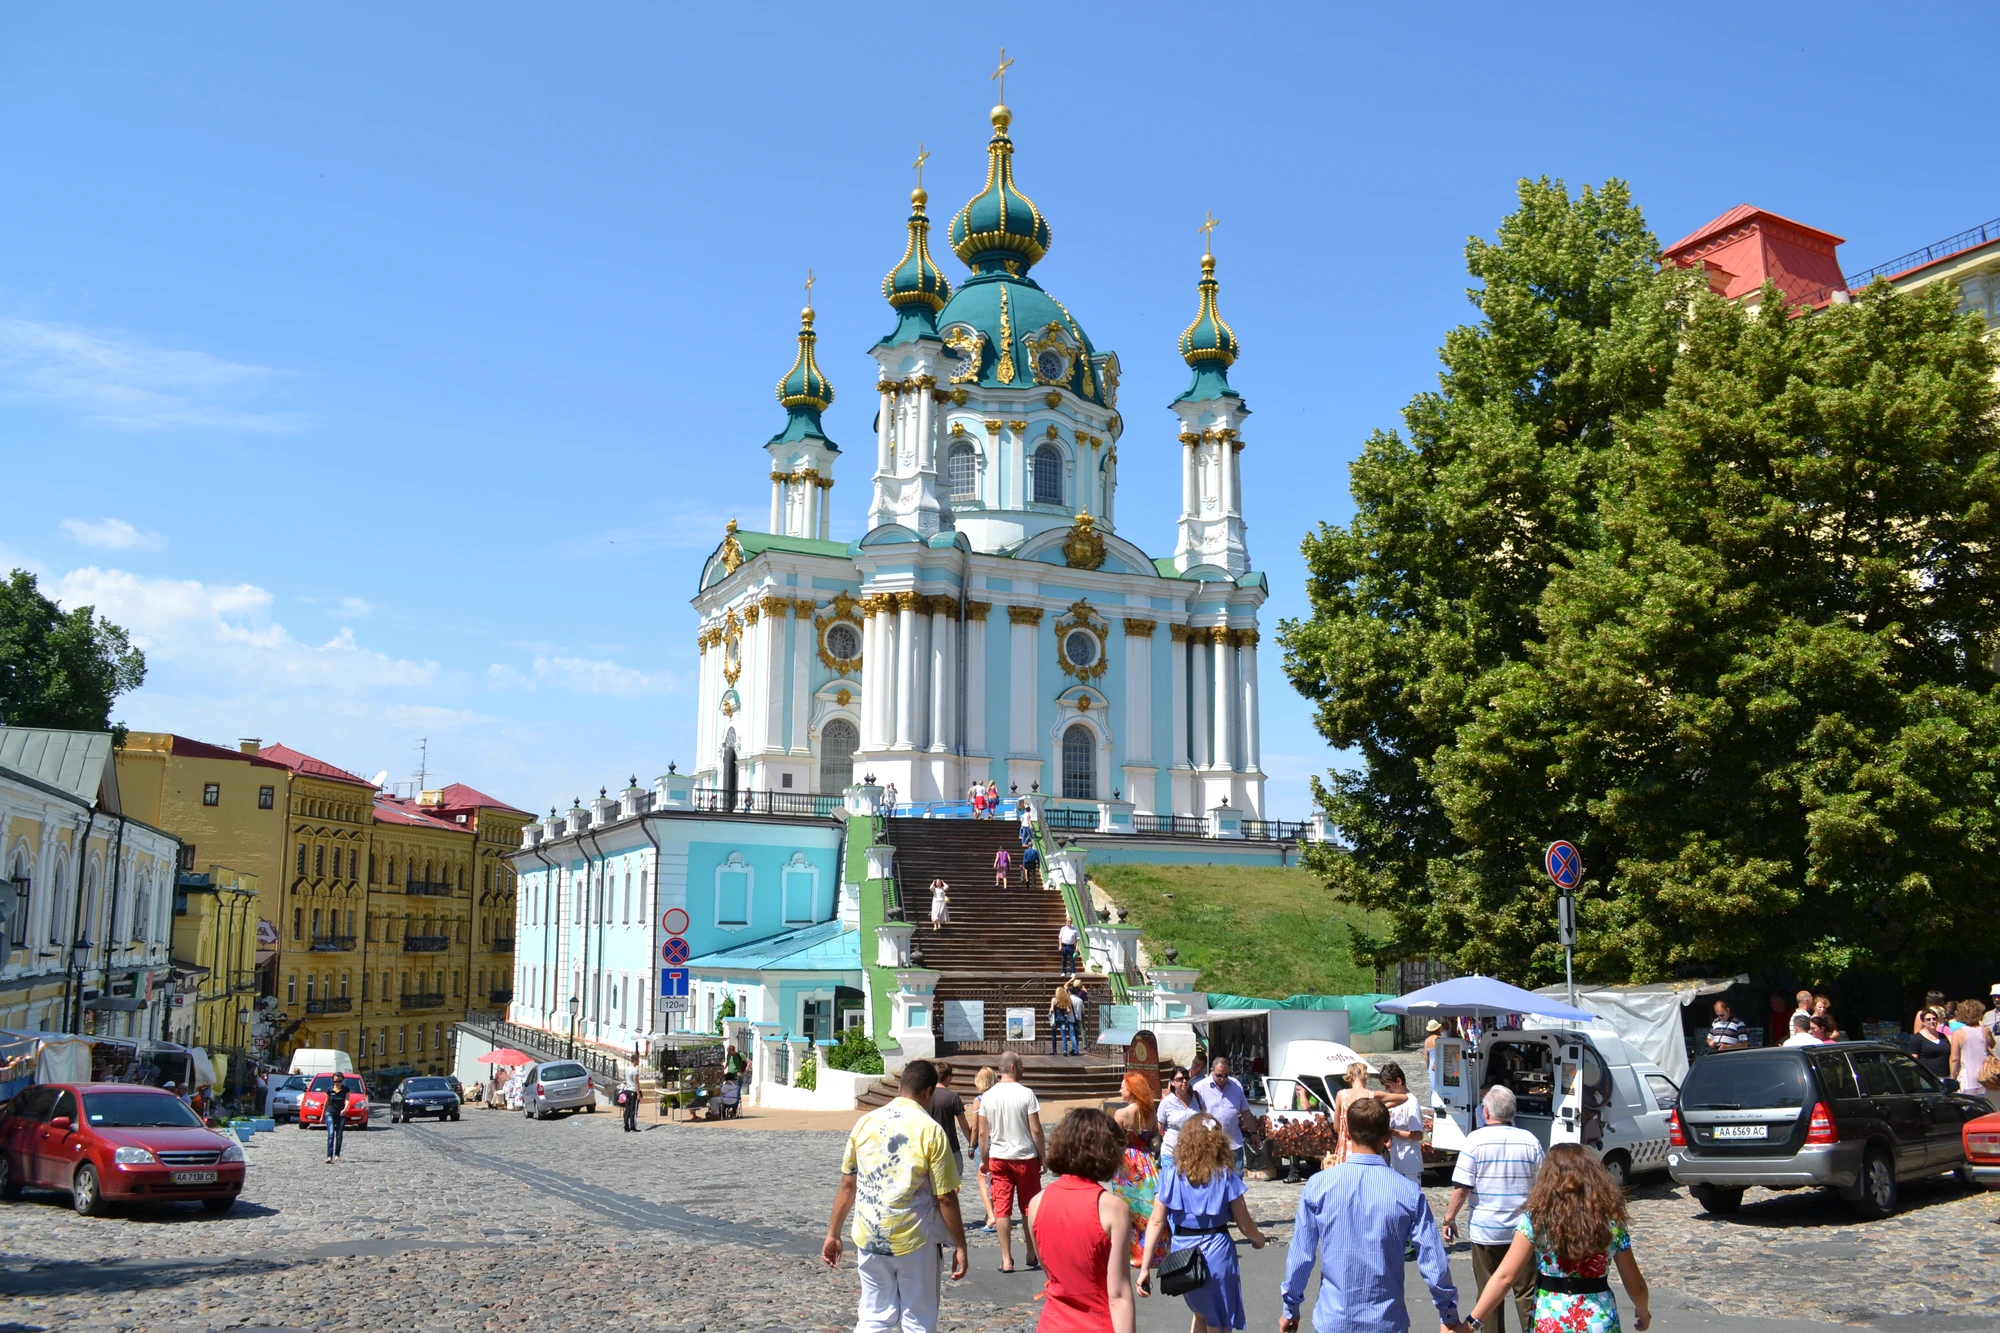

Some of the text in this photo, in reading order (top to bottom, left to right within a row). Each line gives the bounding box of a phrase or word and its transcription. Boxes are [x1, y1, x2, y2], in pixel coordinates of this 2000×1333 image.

[1326, 1053, 1356, 1062] coffee
[1719, 1127, 1731, 1136] AA
[1732, 1126, 1751, 1136] 6569
[1753, 1126, 1765, 1136] AC
